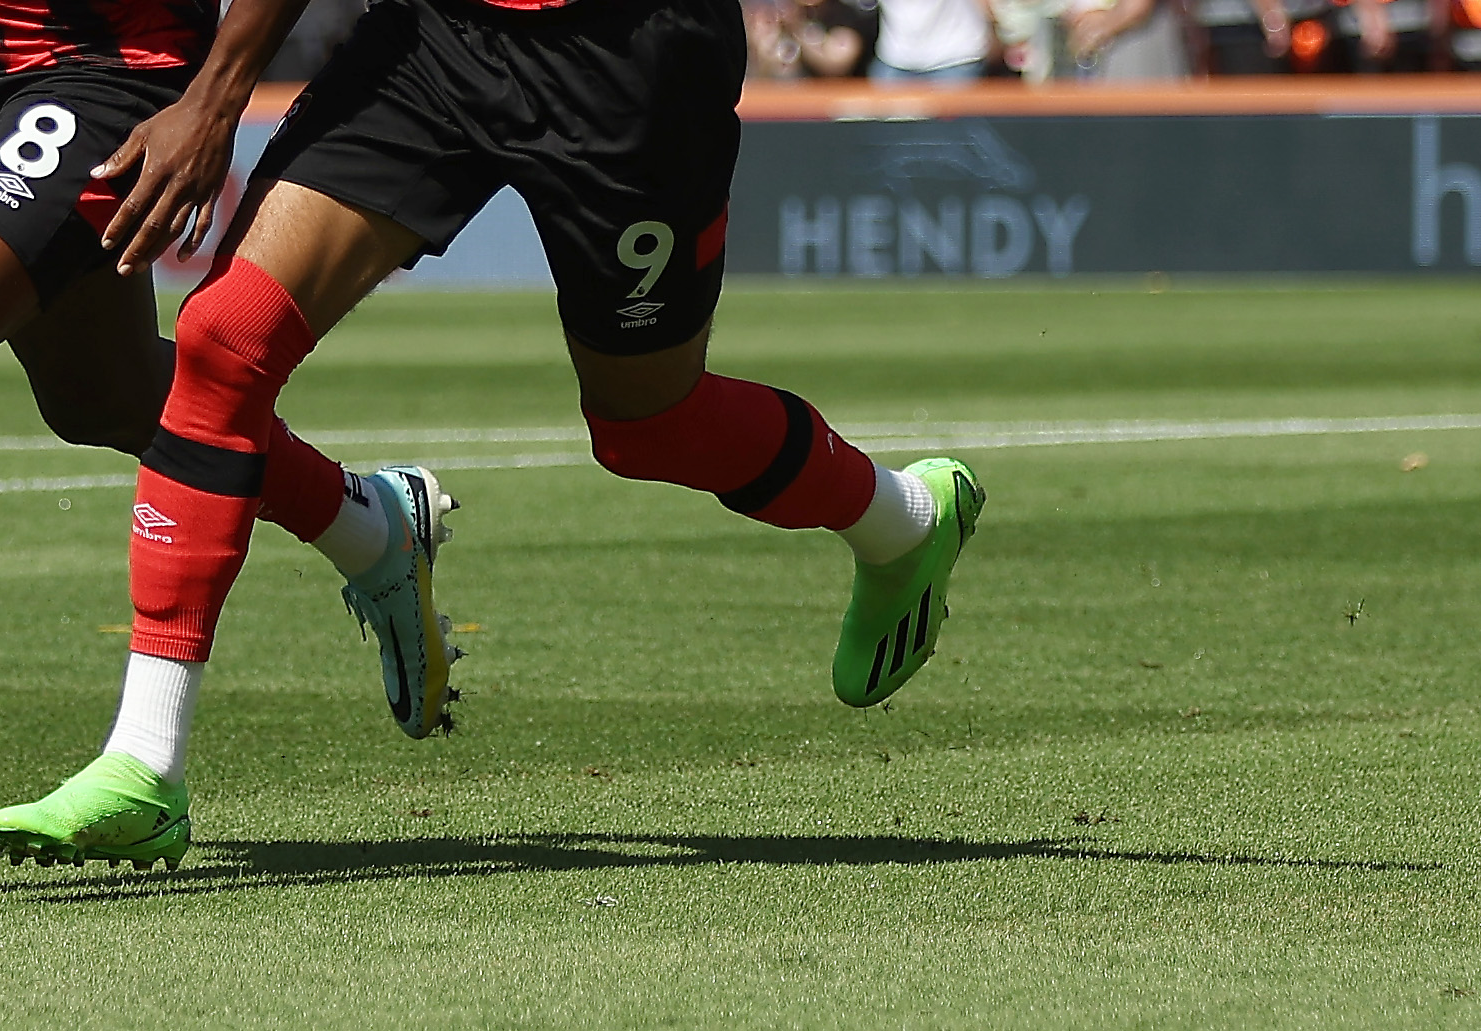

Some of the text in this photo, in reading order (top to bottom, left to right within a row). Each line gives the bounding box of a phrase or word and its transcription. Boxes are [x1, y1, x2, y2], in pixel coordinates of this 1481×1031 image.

[0, 104, 76, 179] 8
[616, 220, 675, 299] 9
[778, 194, 1090, 278] HENDY
[620, 316, 657, 329] umbro
